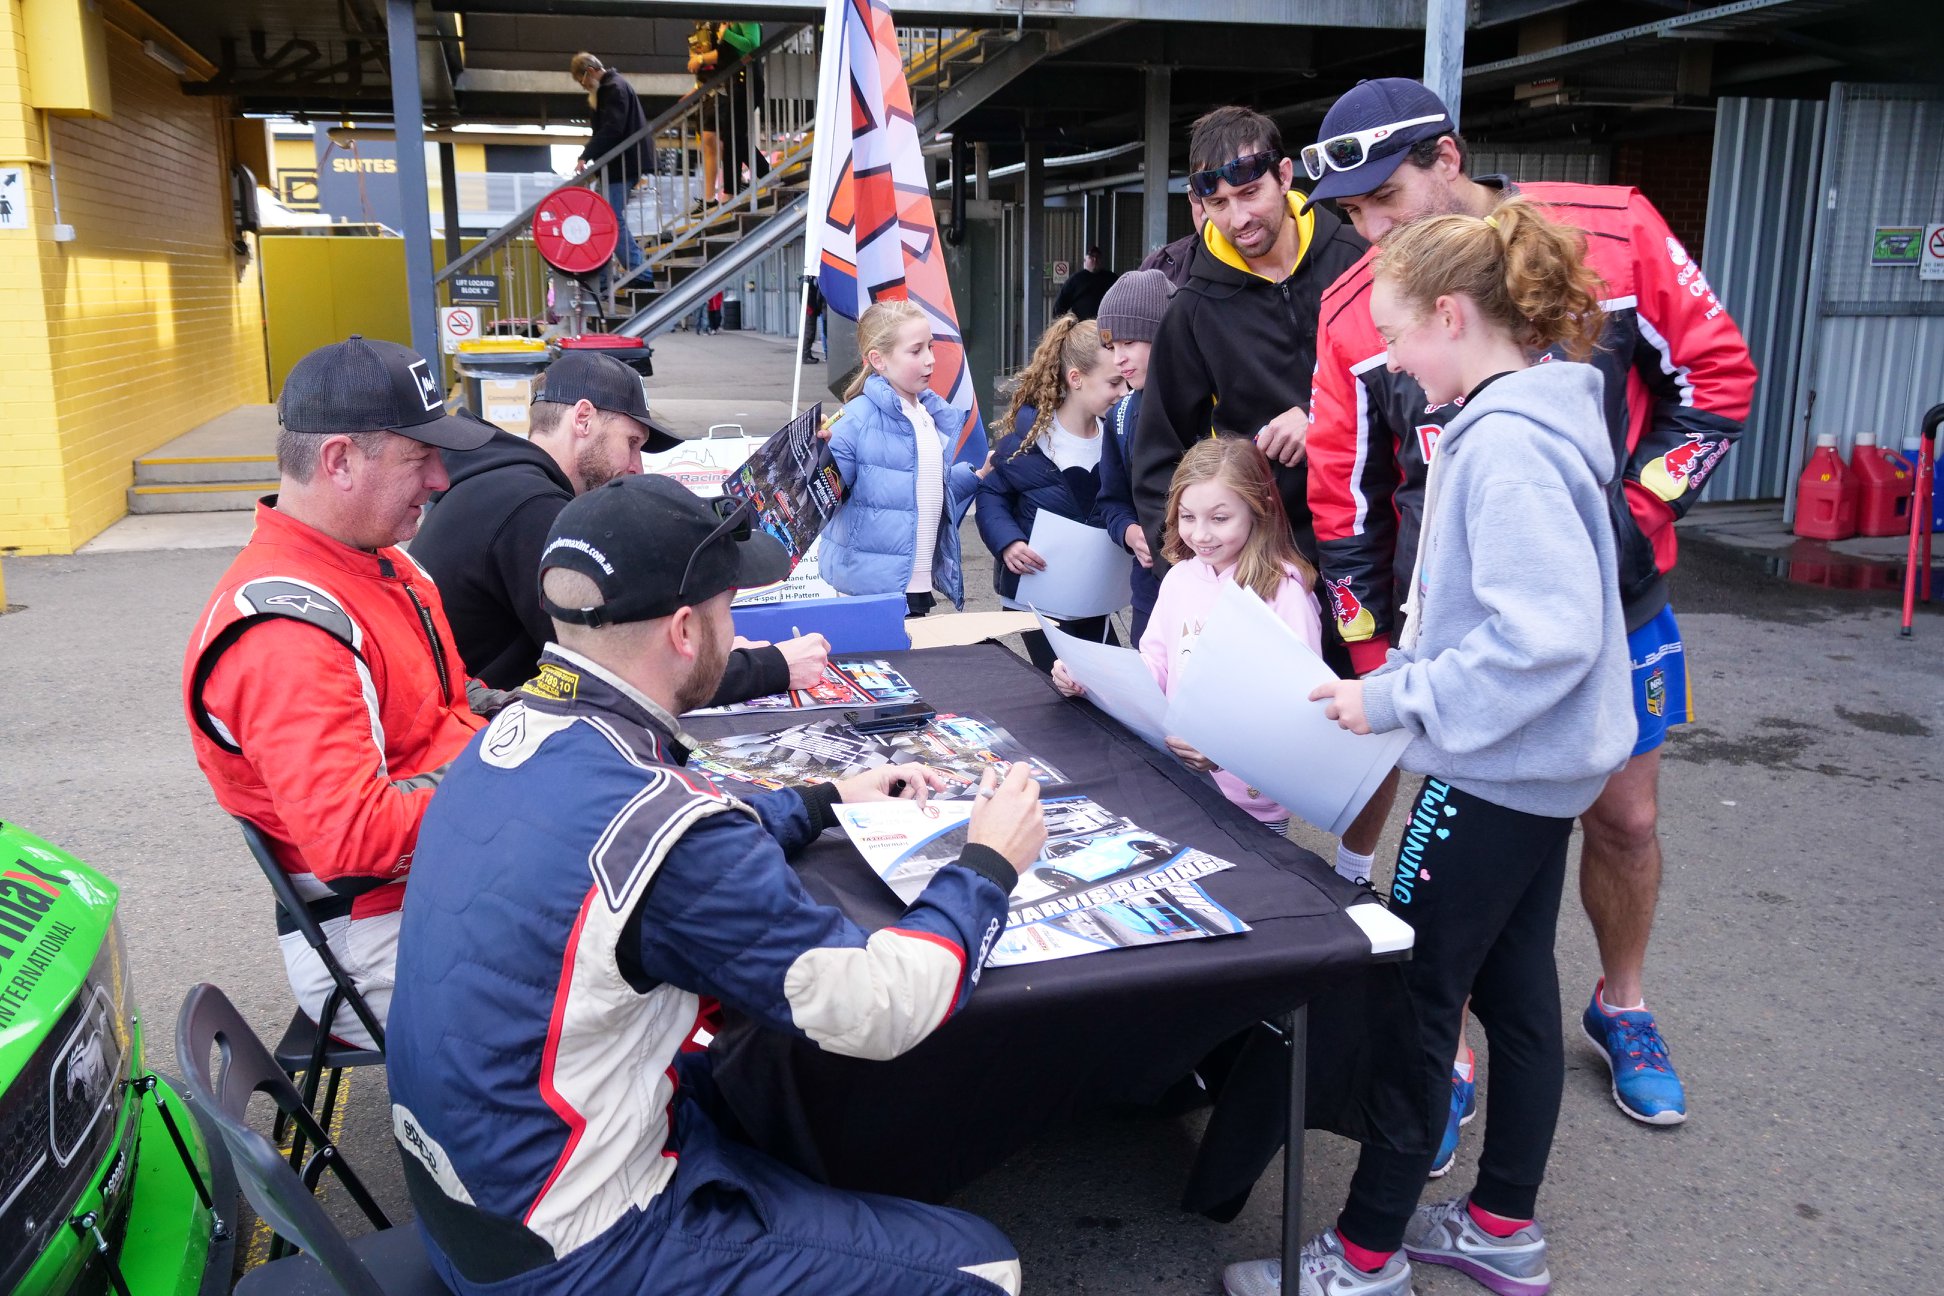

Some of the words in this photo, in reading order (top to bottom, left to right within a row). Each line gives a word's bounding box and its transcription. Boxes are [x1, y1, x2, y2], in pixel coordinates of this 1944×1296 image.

[332, 158, 397, 173] SUITES
[456, 279, 468, 287] LIFT
[468, 279, 495, 288] LOCATED
[681, 472, 730, 483] Racing
[805, 573, 820, 582] fuel
[785, 592, 820, 600] H-Pattern
[1650, 678, 1664, 690] NRL
[1393, 779, 1450, 904] TWINNING
[1114, 857, 1220, 898] RACING
[0, 858, 71, 960] max
